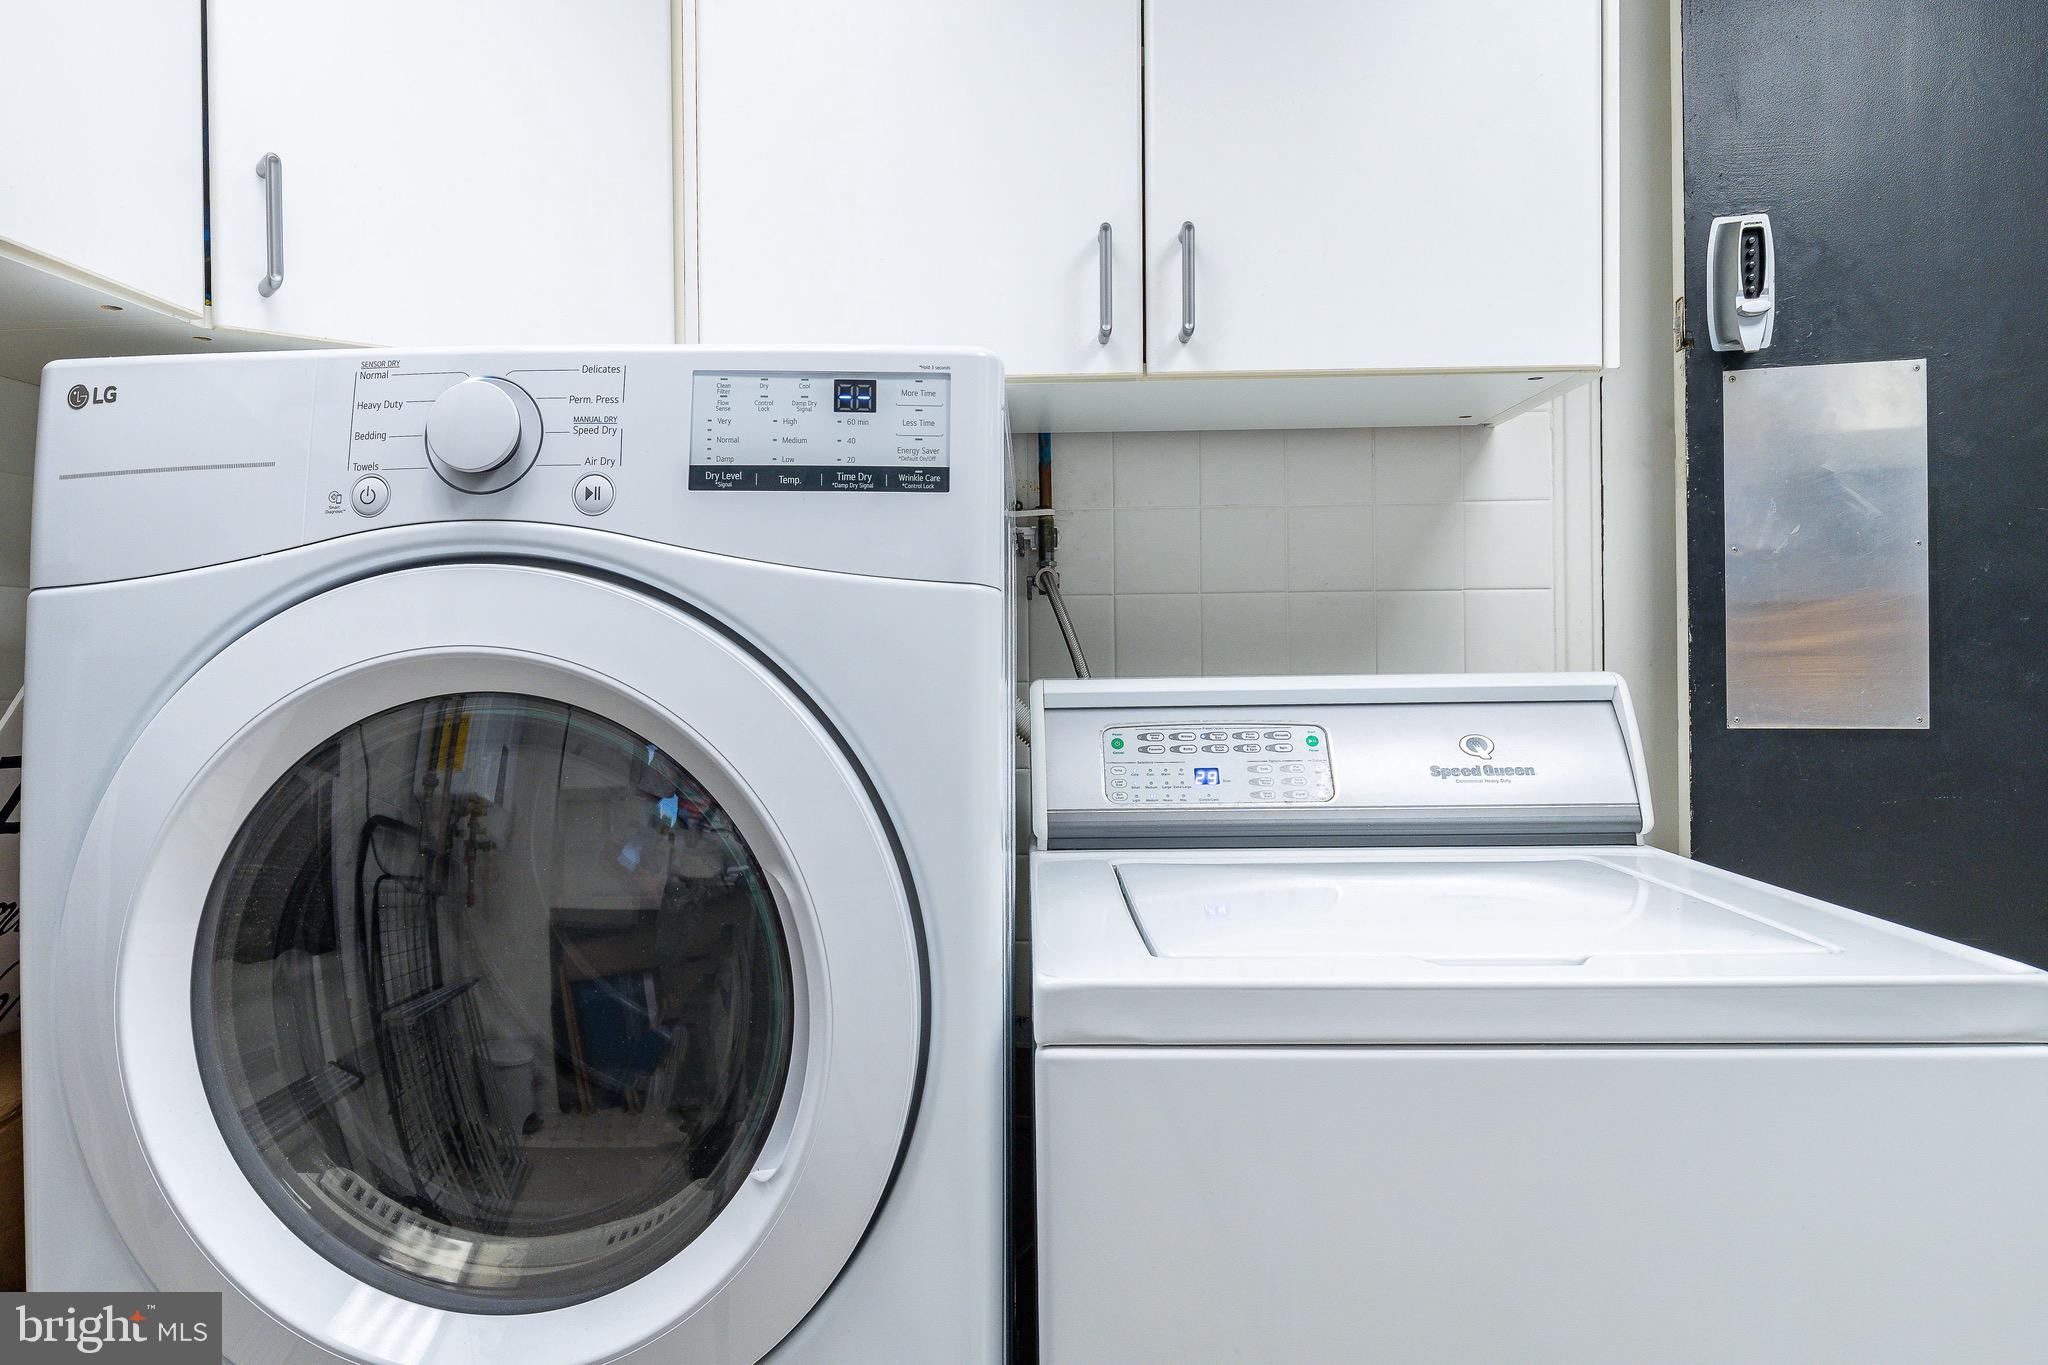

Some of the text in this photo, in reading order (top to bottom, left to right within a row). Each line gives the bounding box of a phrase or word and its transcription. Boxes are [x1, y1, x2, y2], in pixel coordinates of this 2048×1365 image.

[582, 364, 620, 374] Delicates
[360, 371, 388, 380] Normal
[93, 386, 118, 404] LG
[569, 395, 619, 404] Perm. Press
[357, 400, 403, 411] Heavy Duty
[573, 426, 617, 436] Speed Dry
[354, 431, 386, 442] Bedding
[897, 447, 920, 456] Energy
[353, 462, 379, 471] Towels
[584, 457, 615, 468] Air Dry
[705, 471, 742, 481] Dry Level
[779, 475, 802, 486] Temp.
[836, 472, 872, 482] Time Dry
[1430, 764, 1536, 779] Speed Queen
[1195, 770, 1217, 785] 29
